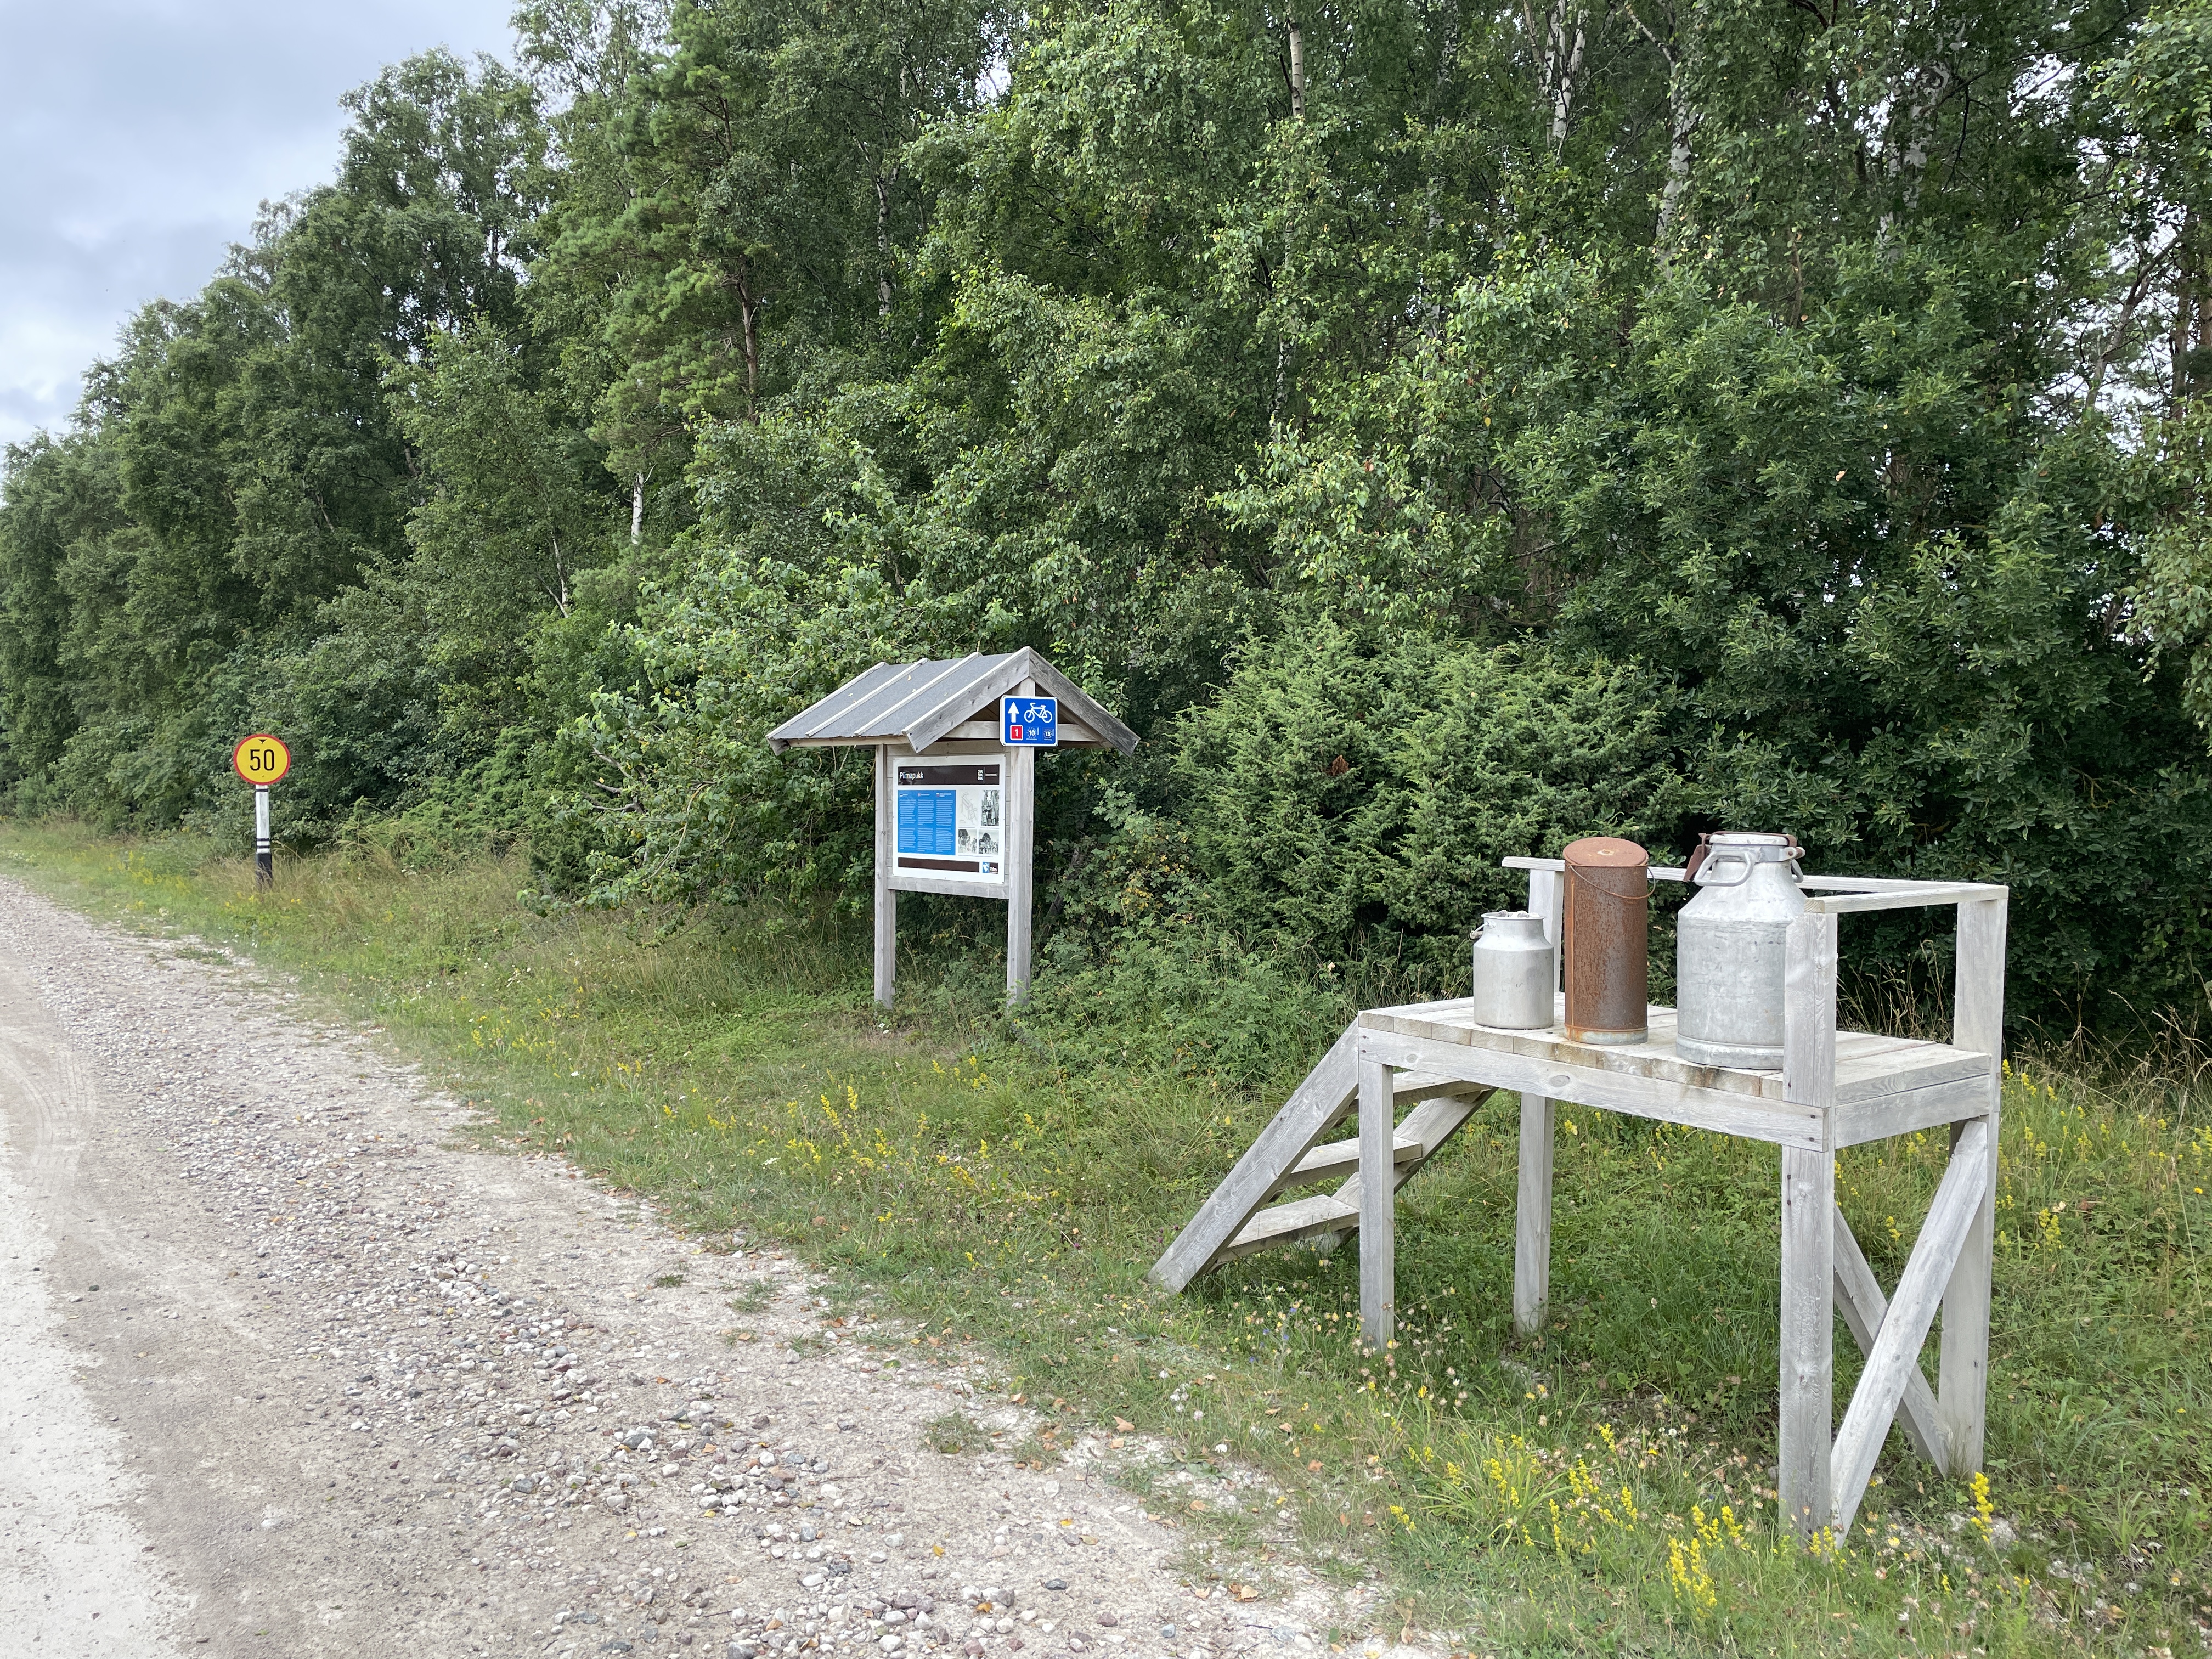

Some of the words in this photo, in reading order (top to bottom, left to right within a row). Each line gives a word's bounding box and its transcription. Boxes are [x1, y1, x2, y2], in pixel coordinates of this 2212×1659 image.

[1014, 729, 1019, 737] 1
[250, 749, 274, 771] 50
[900, 771, 924, 780] Piimapukk
